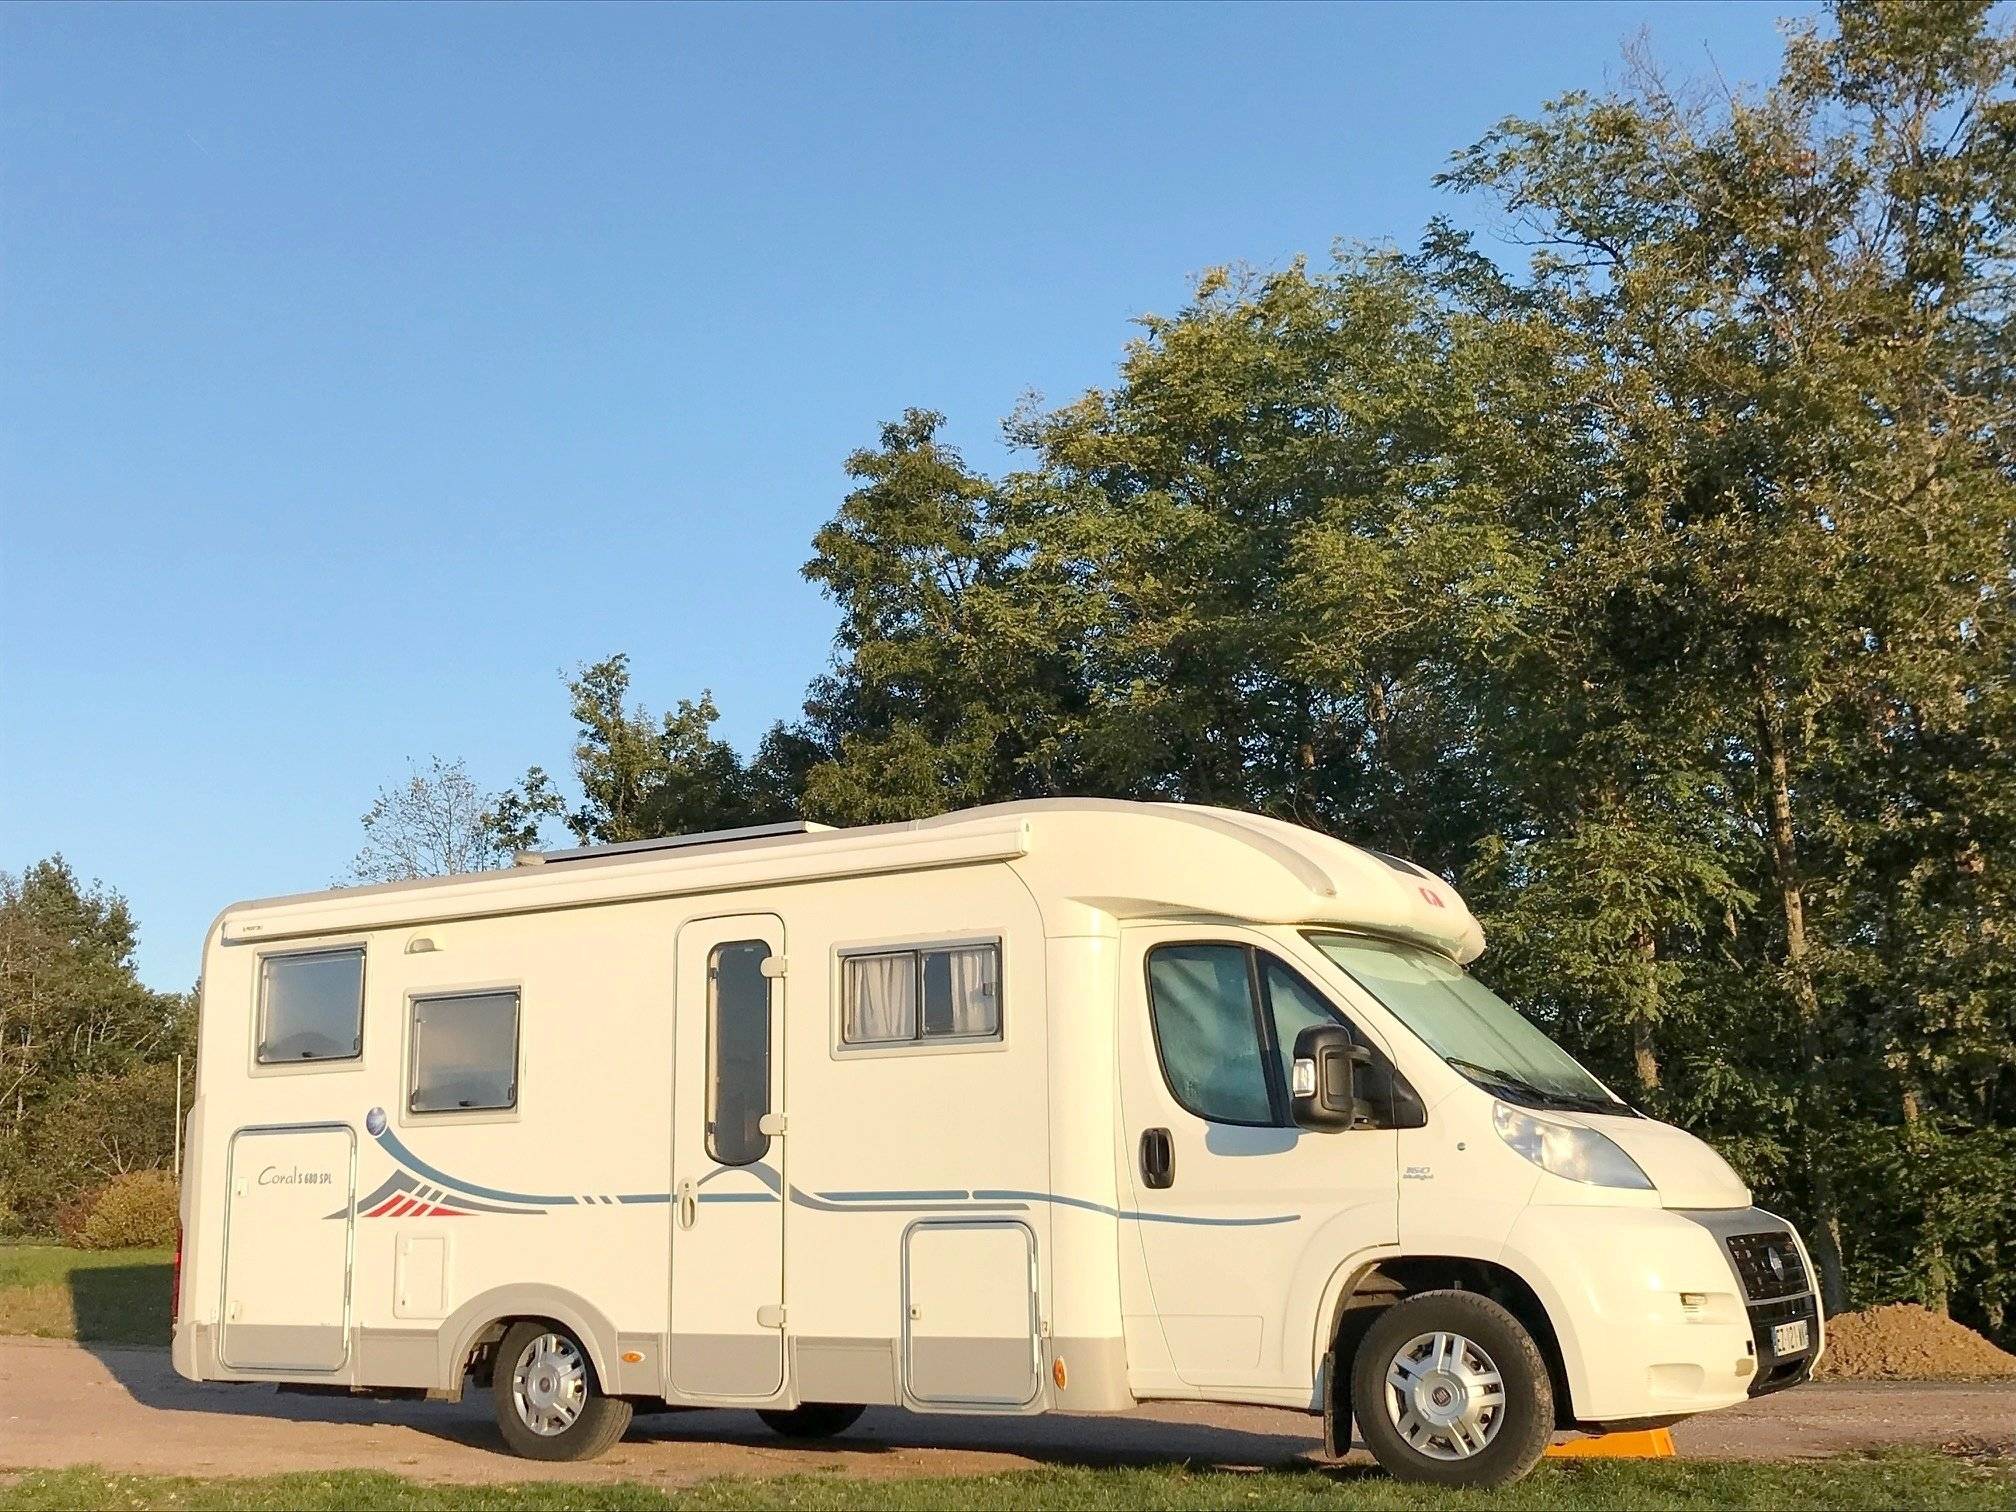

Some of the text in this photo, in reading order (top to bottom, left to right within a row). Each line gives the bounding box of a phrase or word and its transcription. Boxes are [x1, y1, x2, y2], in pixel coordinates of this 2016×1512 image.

[258, 1165, 297, 1186] Coral
[304, 1173, 318, 1184] 680
[319, 1173, 332, 1184] SPL
